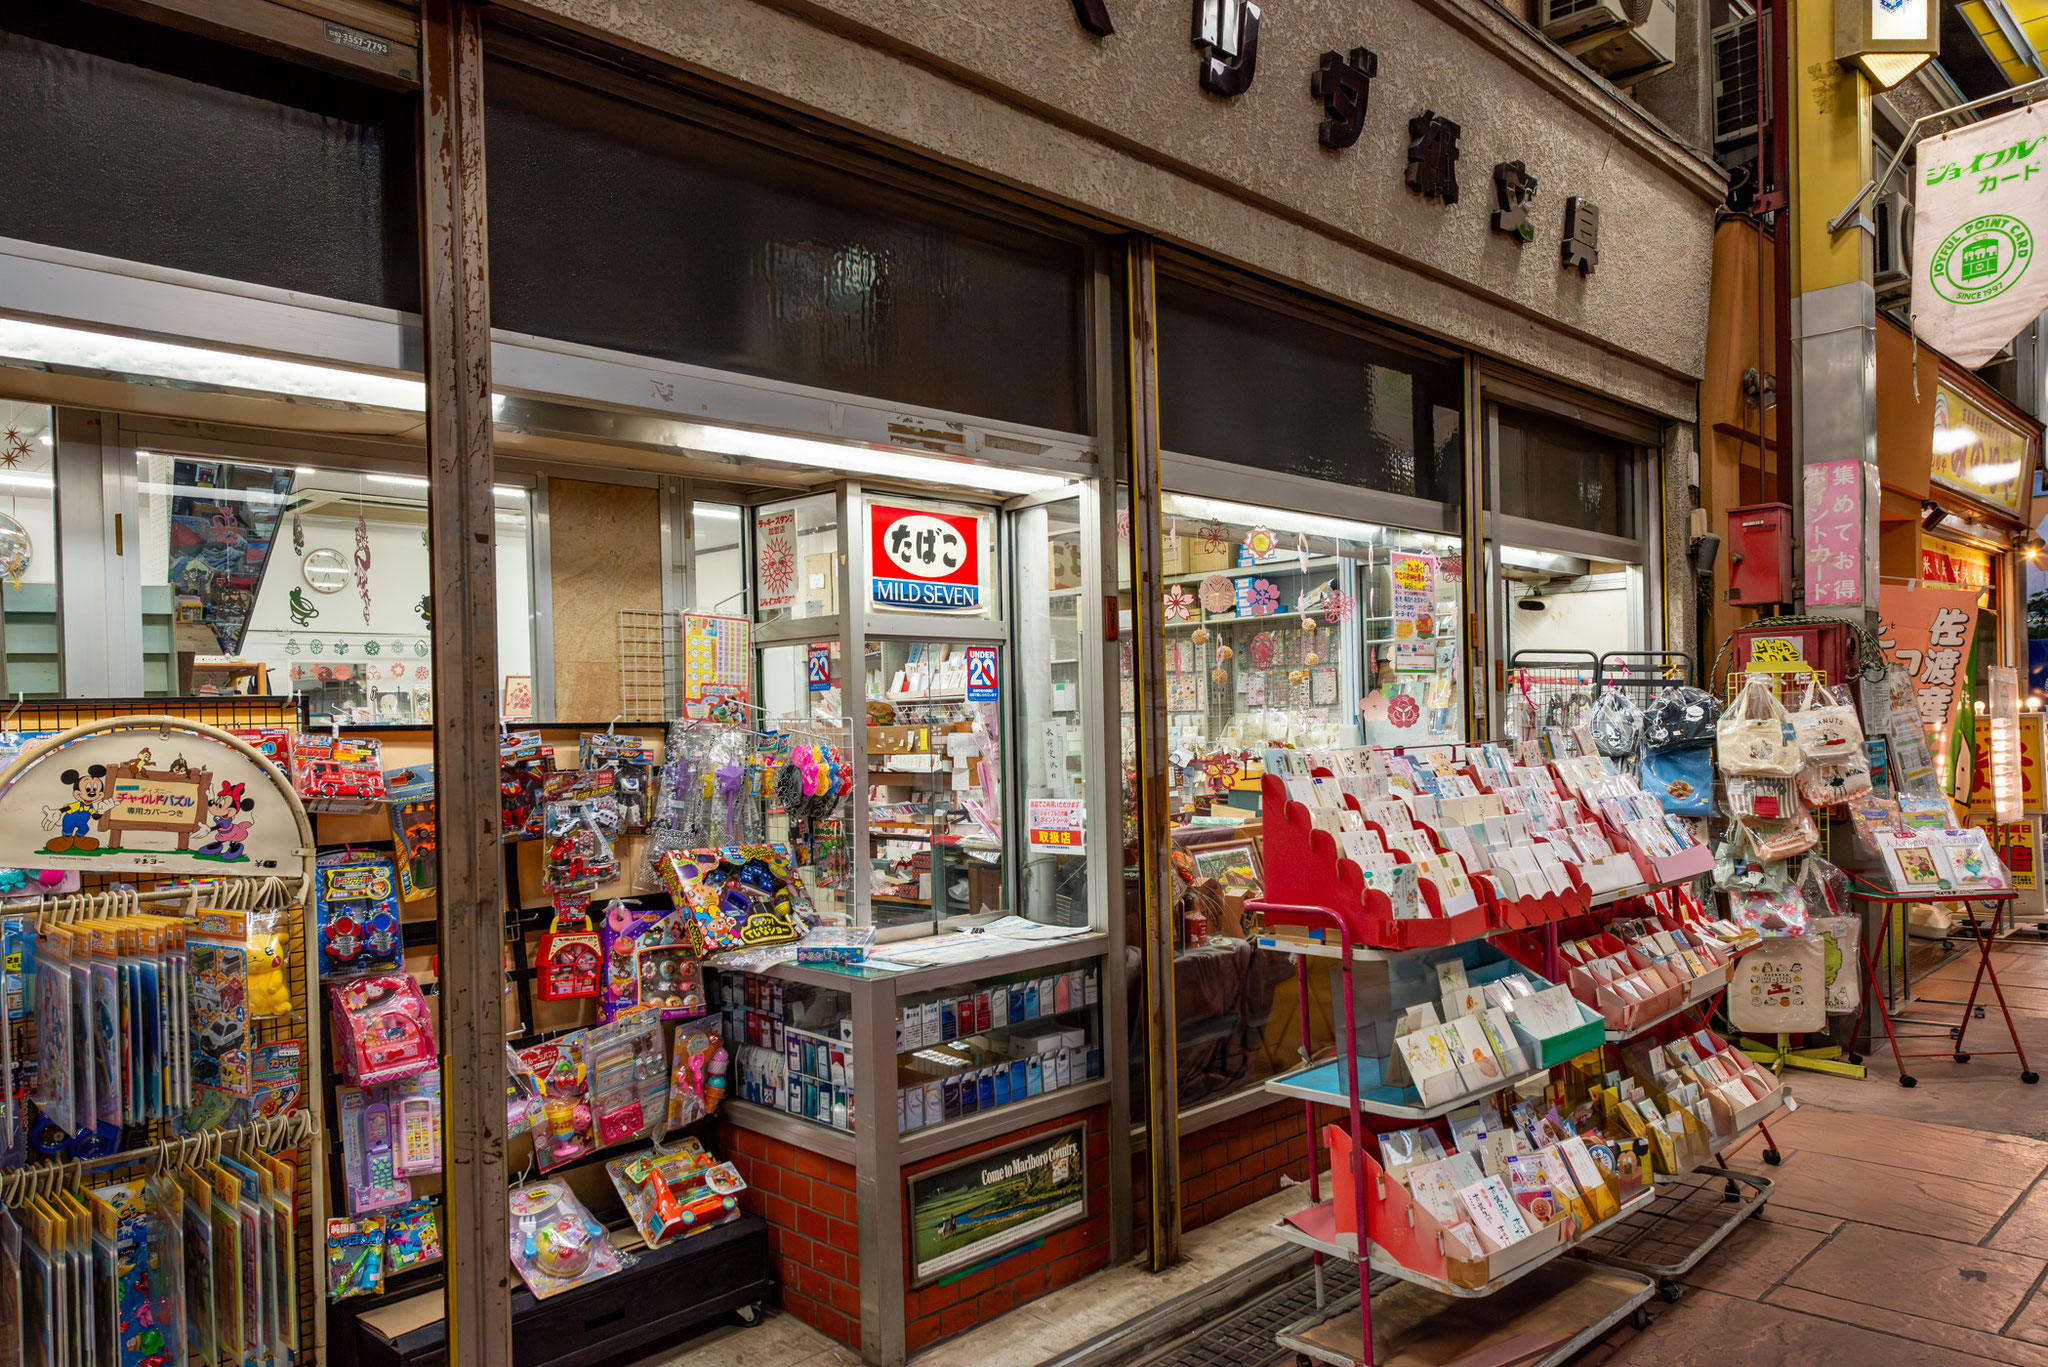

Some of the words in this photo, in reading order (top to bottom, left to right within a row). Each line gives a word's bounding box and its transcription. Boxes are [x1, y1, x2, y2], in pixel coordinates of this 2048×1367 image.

[1926, 136, 2046, 187] ジョイフル
[1978, 165, 2040, 194] カード
[1933, 235, 1961, 278] JOYFUL
[2009, 224, 2031, 259] CARD
[1956, 291, 1982, 301] SINCE
[1983, 282, 2005, 298] 1997
[891, 523, 958, 568] たばこ
[1807, 465, 1830, 602] ポイントカード
[1832, 465, 1857, 600] 集めてお得
[877, 580, 921, 603] MILD
[922, 583, 975, 607] SEVEN
[809, 650, 829, 658] UNDER
[969, 650, 995, 659] UNDER
[1917, 607, 1970, 724] 佐渡産
[809, 658, 830, 682] 20
[970, 658, 996, 686] 20
[1818, 717, 1844, 726] ANUTS
[116, 792, 195, 807] チャイルドパズル
[591, 785, 614, 797] RANGER
[127, 807, 184, 817] 専用カバーつき
[1038, 830, 1071, 845] 取扱店
[981, 1168, 1004, 1186] Come
[1004, 1164, 1013, 1178] to
[1012, 1153, 1048, 1174] Marlboro
[1048, 1142, 1078, 1163] Country.
